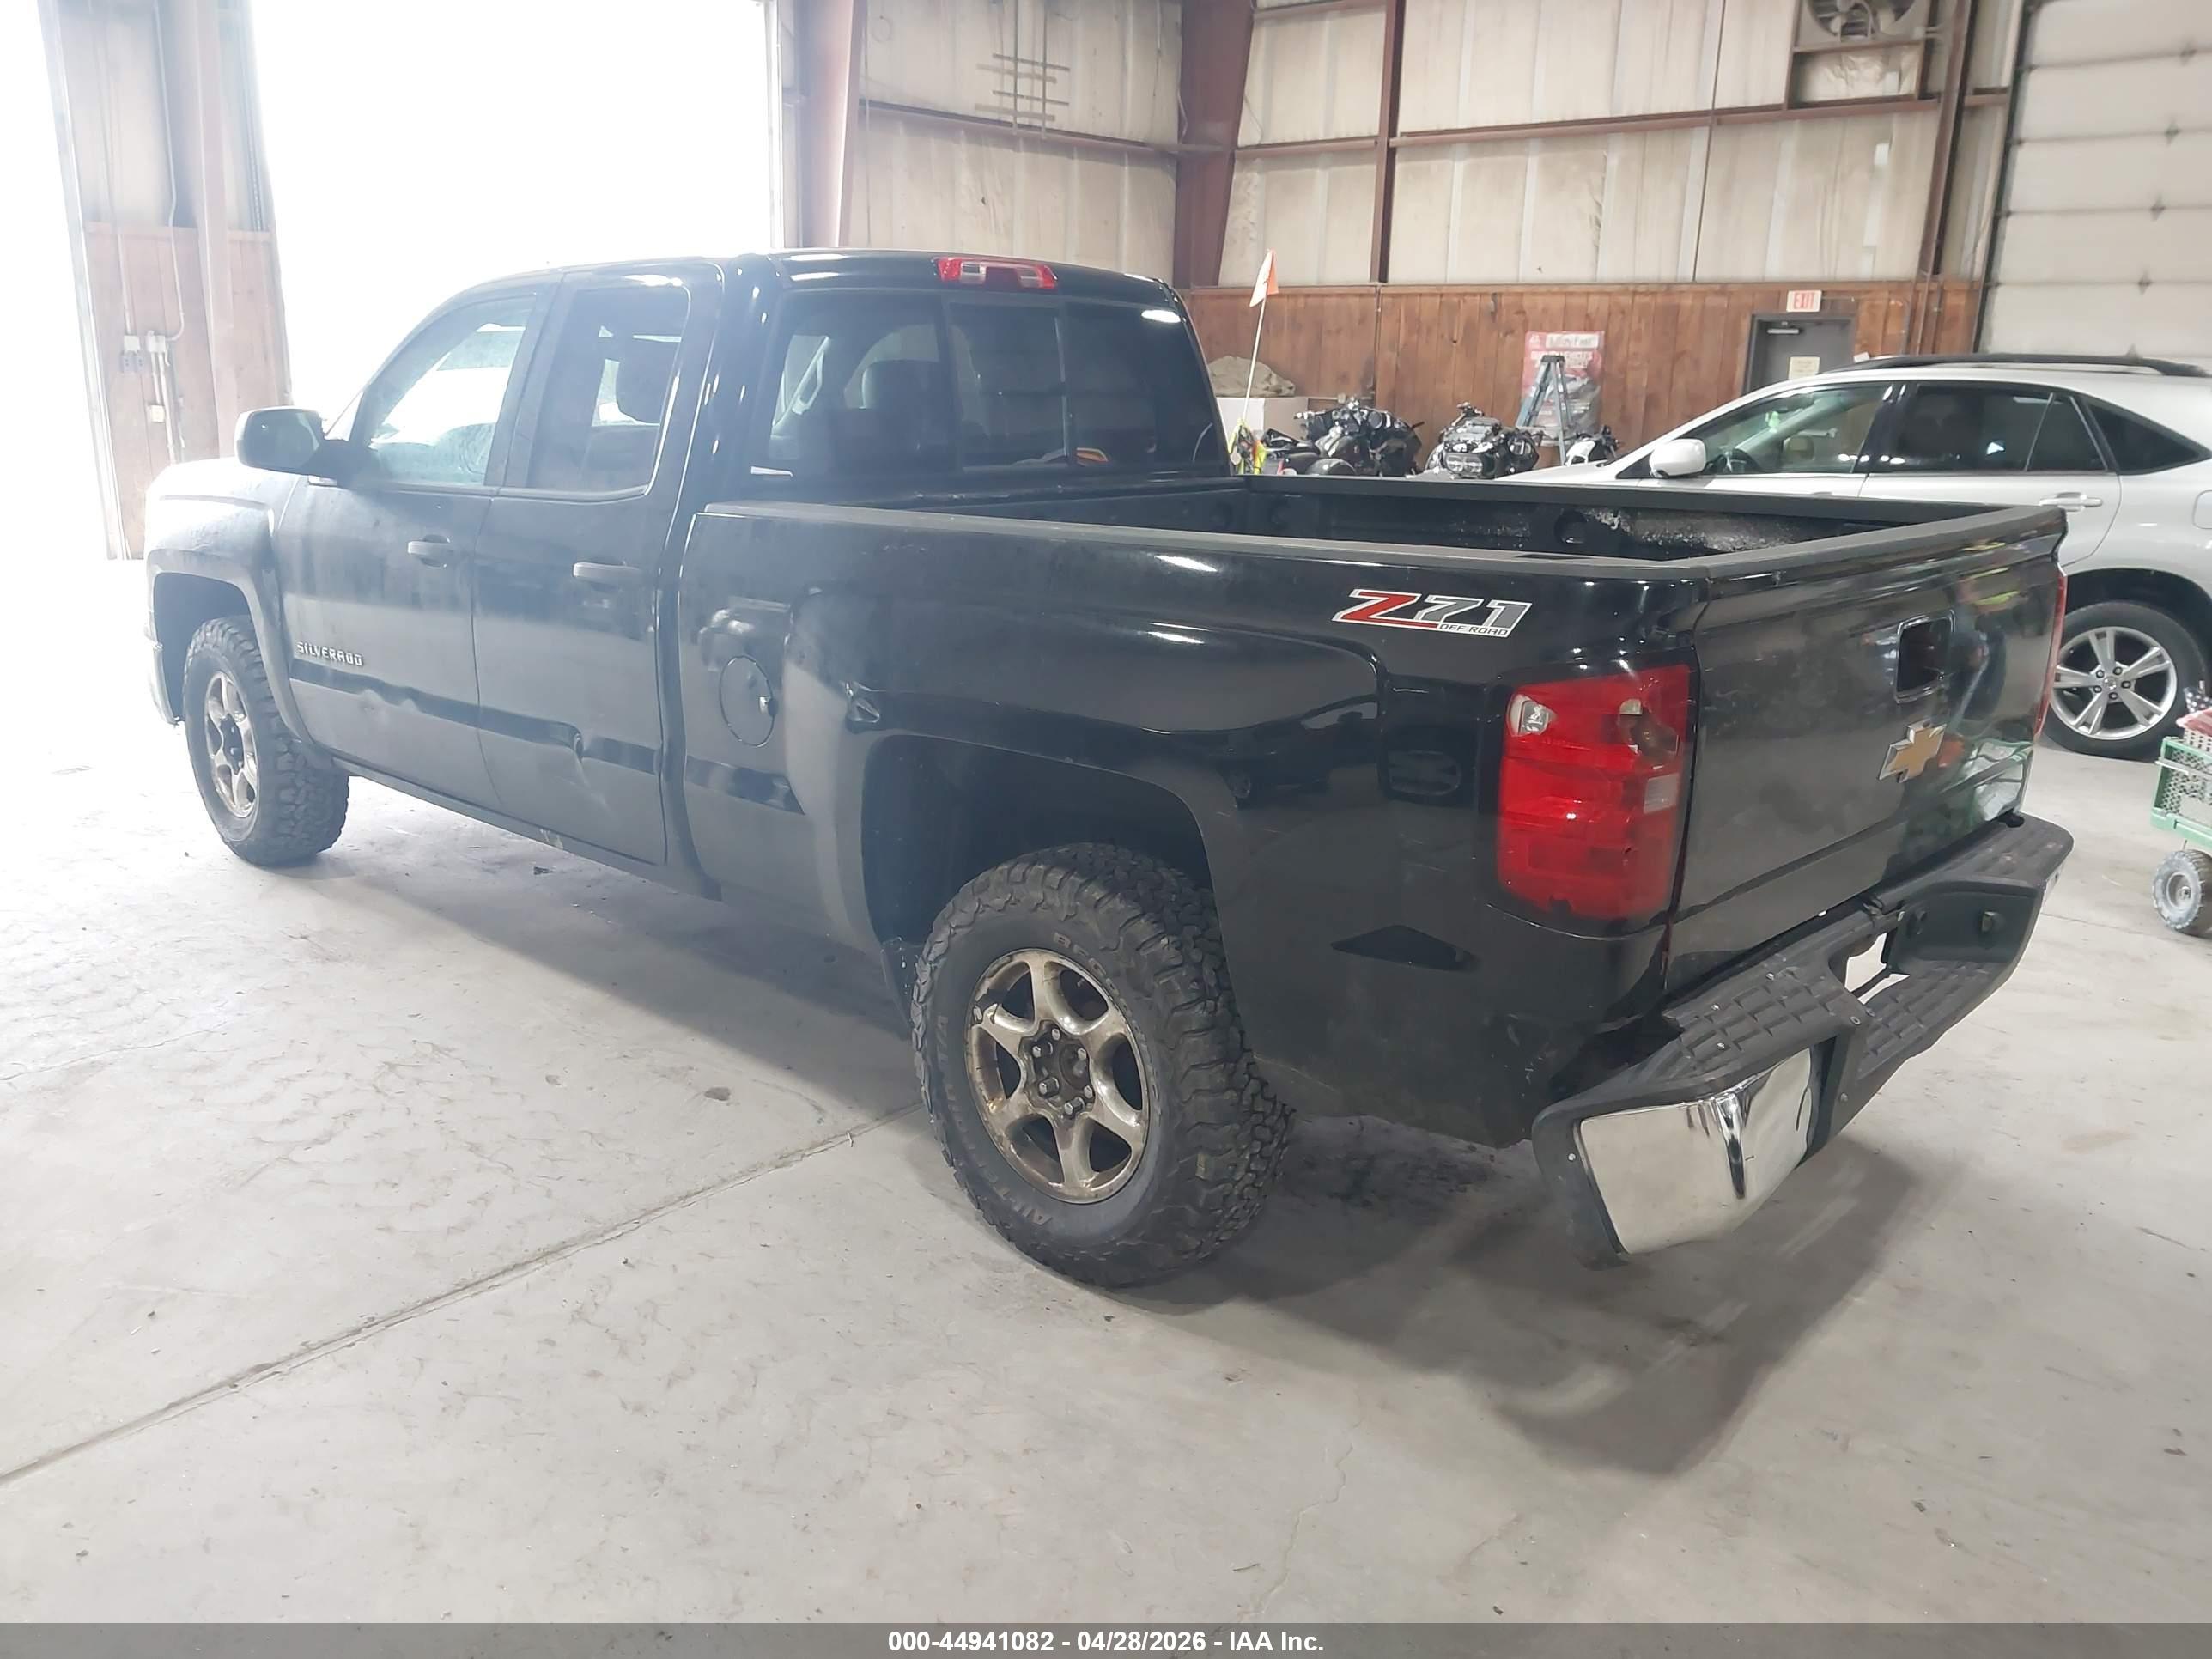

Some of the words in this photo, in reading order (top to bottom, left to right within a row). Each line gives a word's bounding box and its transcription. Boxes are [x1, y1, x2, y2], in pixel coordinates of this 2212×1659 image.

[1793, 291, 1815, 310] EXIT
[1331, 588, 1533, 631] Z71
[1439, 623, 1467, 632] OFF
[1468, 626, 1509, 637] ROAD
[296, 641, 363, 666] SILVERADO
